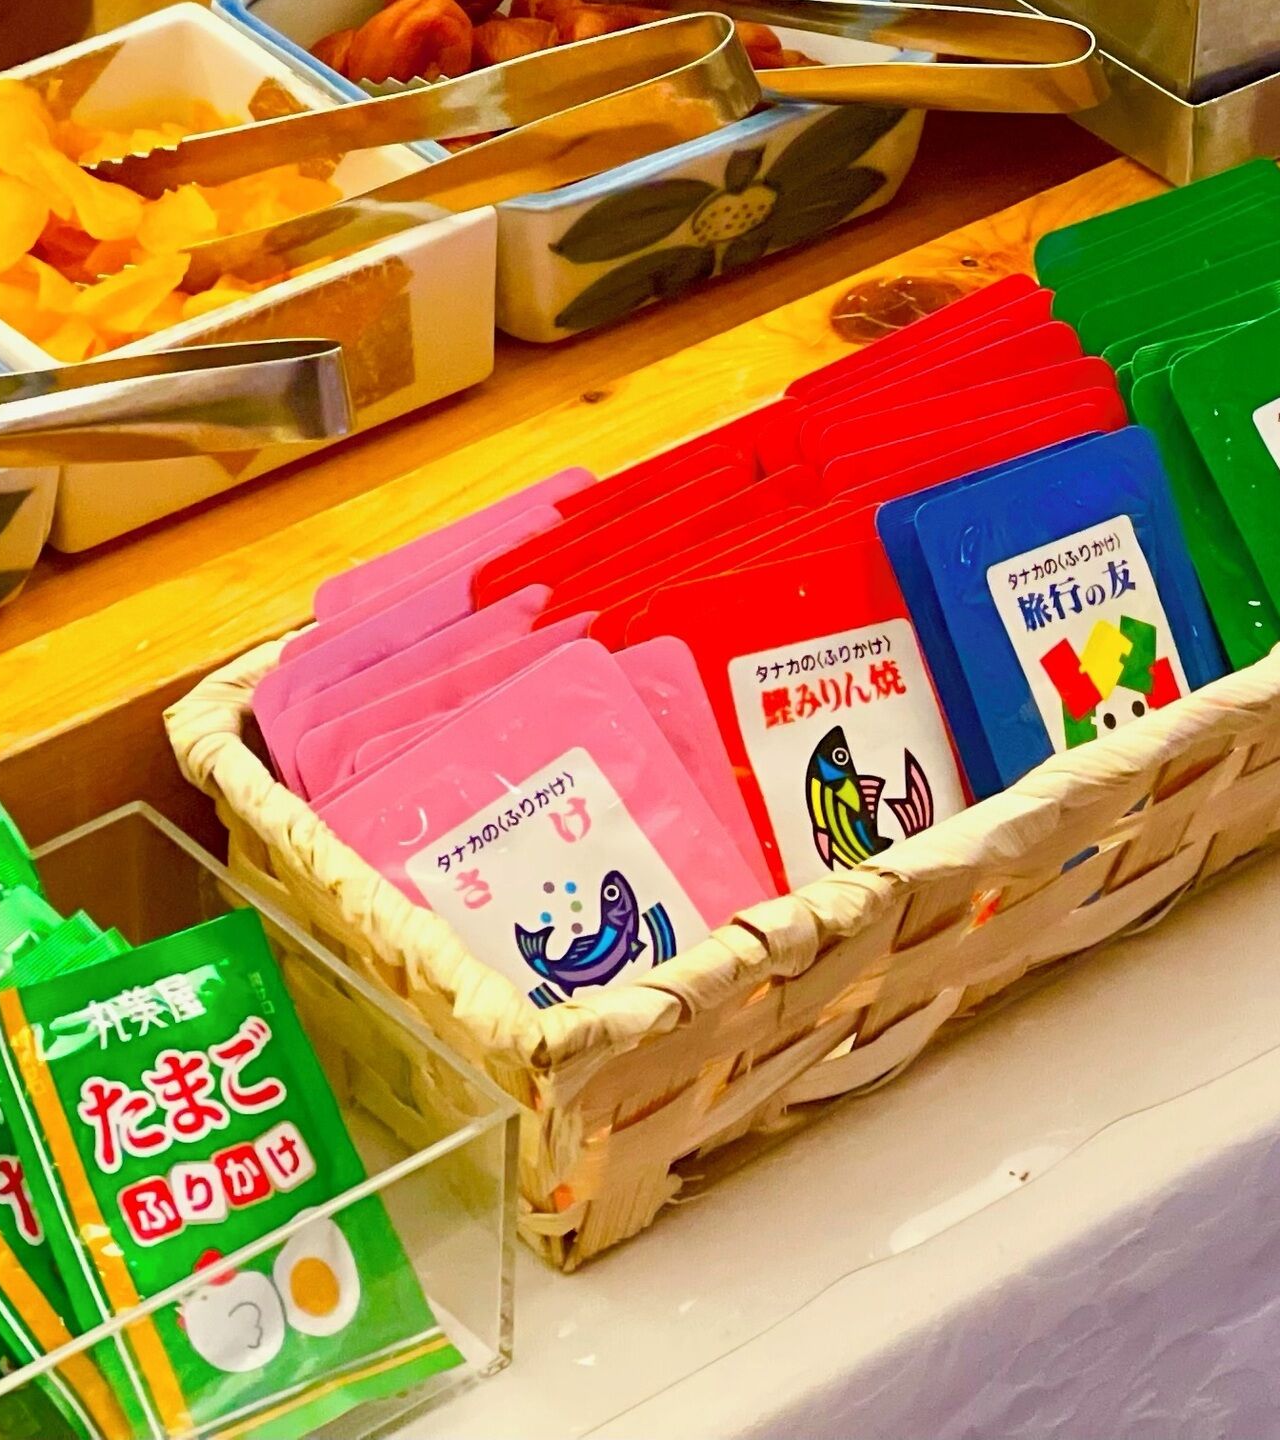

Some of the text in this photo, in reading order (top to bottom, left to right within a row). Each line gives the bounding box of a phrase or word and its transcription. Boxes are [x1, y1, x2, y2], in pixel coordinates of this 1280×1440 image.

[1018, 560, 1136, 632] 旅行の友
[762, 660, 906, 728] 鰹みりん焼
[78, 1016, 287, 1174] たまご
[122, 1132, 304, 1236] ふりかけ
